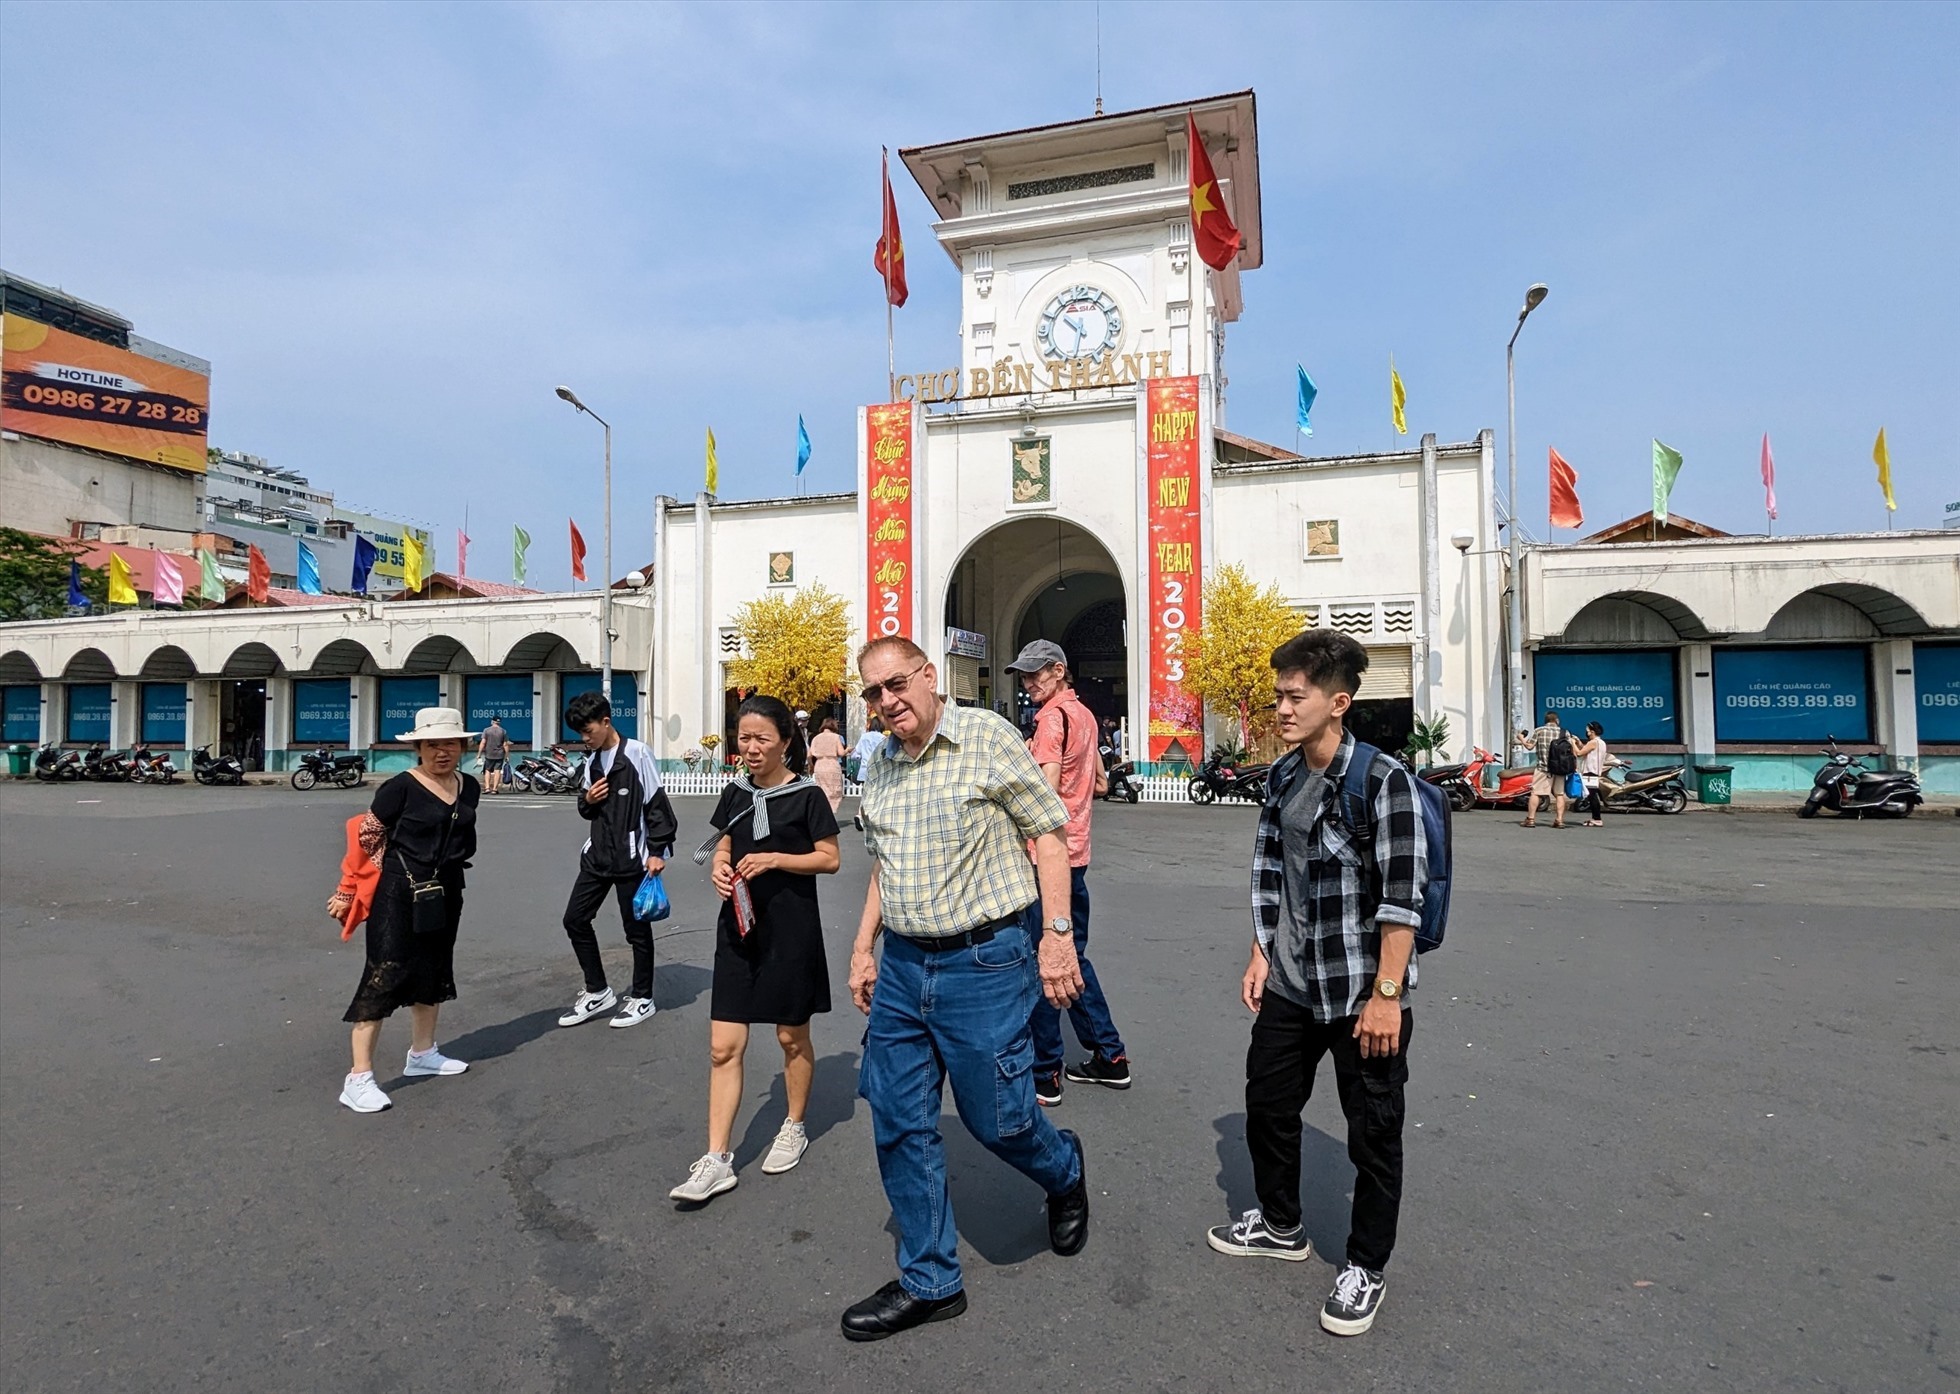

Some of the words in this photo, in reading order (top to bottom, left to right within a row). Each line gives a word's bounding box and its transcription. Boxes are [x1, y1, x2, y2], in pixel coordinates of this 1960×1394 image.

[1071, 284, 1088, 300] 12
[1037, 324, 1050, 337] 9
[1109, 319, 1121, 332] 3
[57, 368, 124, 388] HOTLINE
[895, 366, 960, 404] CHỢ
[970, 355, 1034, 399] BẾN
[23, 384, 96, 411] 0986
[100, 396, 132, 415] 27
[137, 401, 167, 420] 28
[172, 405, 200, 424] 28
[1152, 410, 1197, 443] HAPPY
[874, 436, 907, 465] Chúc
[1158, 476, 1191, 508] NEW
[874, 517, 907, 542] Năm
[1157, 542, 1194, 575] YEAR
[1162, 581, 1186, 682] 2023
[1545, 696, 1664, 709] 0969.39.89.89
[1726, 694, 1857, 708] 0969.39.89.89
[1922, 693, 1960, 707] 096
